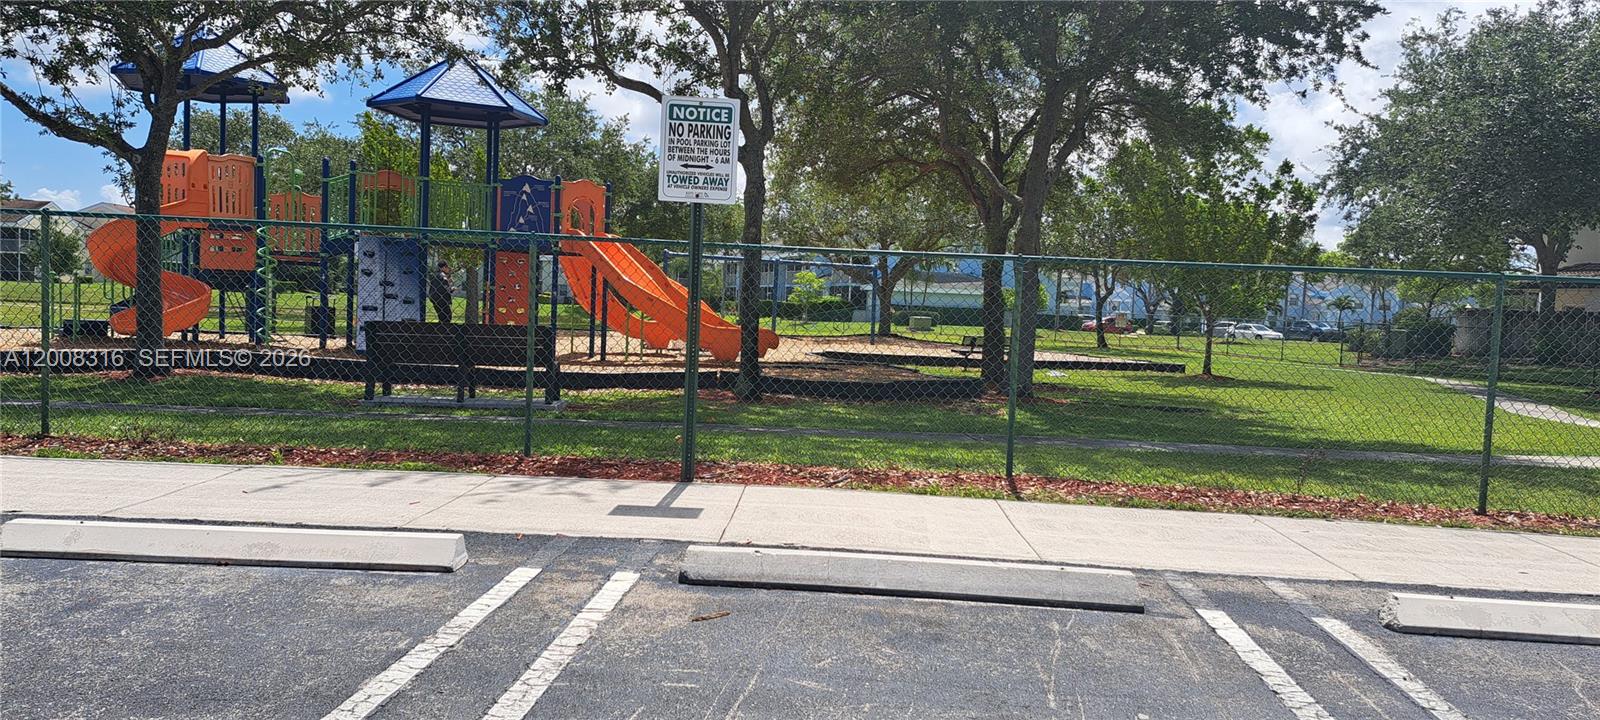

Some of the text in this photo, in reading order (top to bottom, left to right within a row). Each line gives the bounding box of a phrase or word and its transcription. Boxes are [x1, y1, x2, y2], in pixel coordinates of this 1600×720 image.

[673, 107, 728, 121] NOTICE
[669, 122, 731, 140] NO PARKING
[668, 146, 695, 154] BETWEEN
[677, 155, 709, 163] MIDNIGHT
[666, 175, 730, 186] TOWED AWAY
